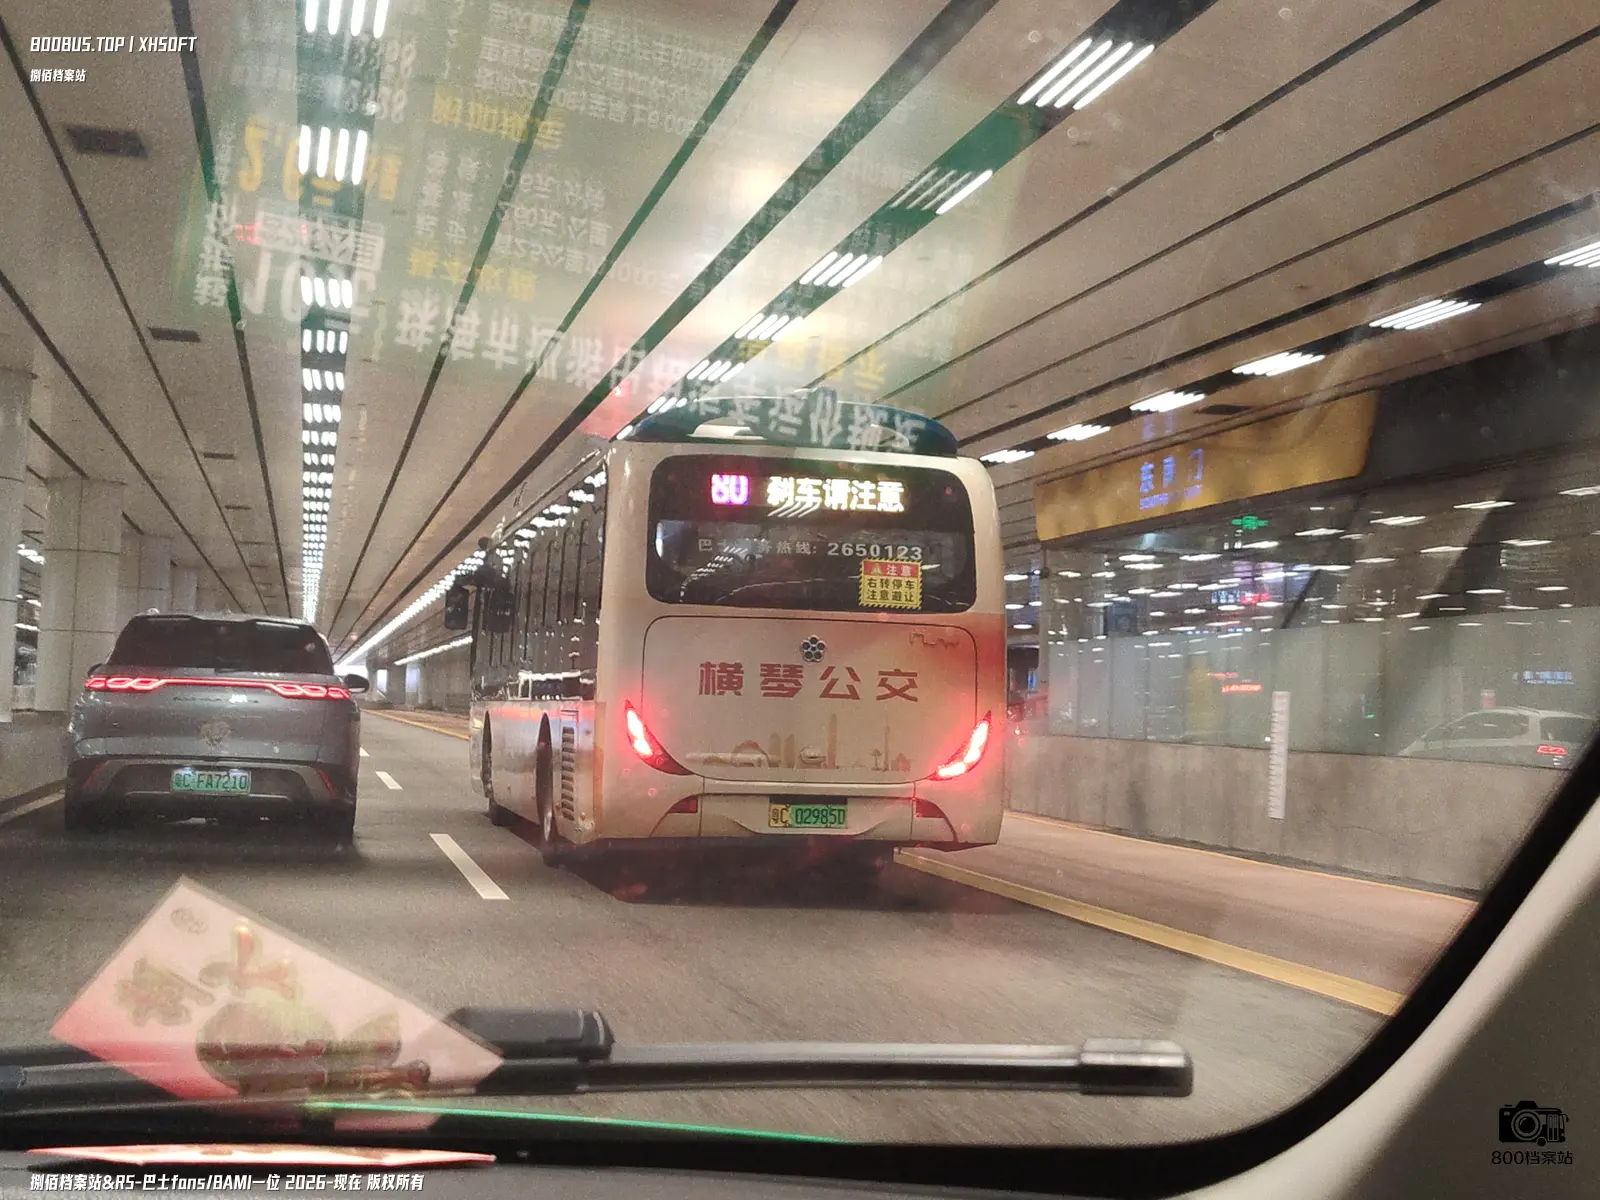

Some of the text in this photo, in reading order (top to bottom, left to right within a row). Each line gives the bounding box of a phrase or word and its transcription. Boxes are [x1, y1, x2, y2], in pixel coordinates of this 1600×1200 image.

[827, 543, 922, 560] 2650123
[698, 661, 918, 702] 横琴公交
